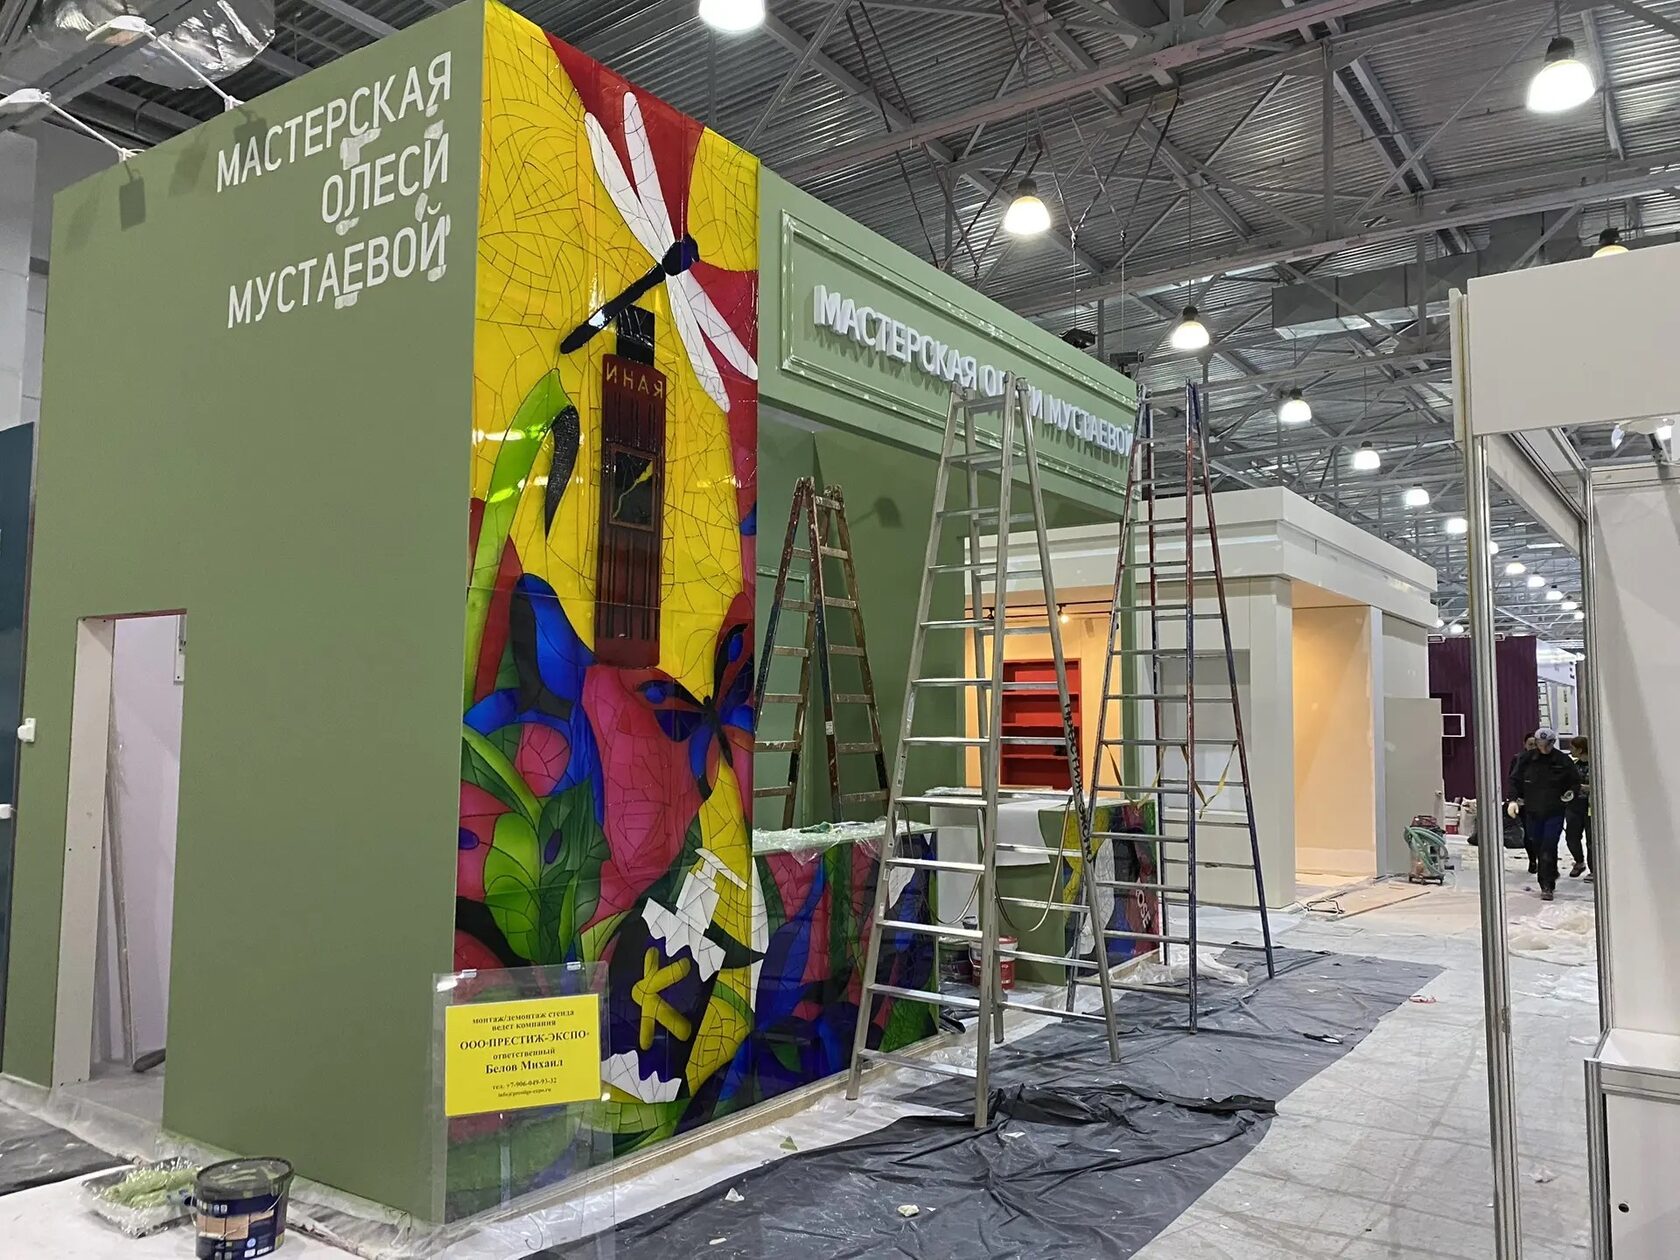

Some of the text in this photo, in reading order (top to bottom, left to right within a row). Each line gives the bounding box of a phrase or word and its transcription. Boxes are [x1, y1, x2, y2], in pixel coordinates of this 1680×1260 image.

[217, 51, 452, 192] МАСТЕРСКАЯ
[321, 133, 449, 223] ОЛЕСИ
[227, 202, 448, 328] МУСТАЕВОЙ
[813, 284, 977, 391] МАСТЕРСКАЯ
[1043, 394, 1134, 457] МУСТАЕВОЙ
[472, 1009, 575, 1025] монтаж/демонтаж стенда
[491, 1020, 557, 1032] ведет компания
[485, 1058, 564, 1075] Белов Михаил
[492, 1048, 556, 1061] ответственный
